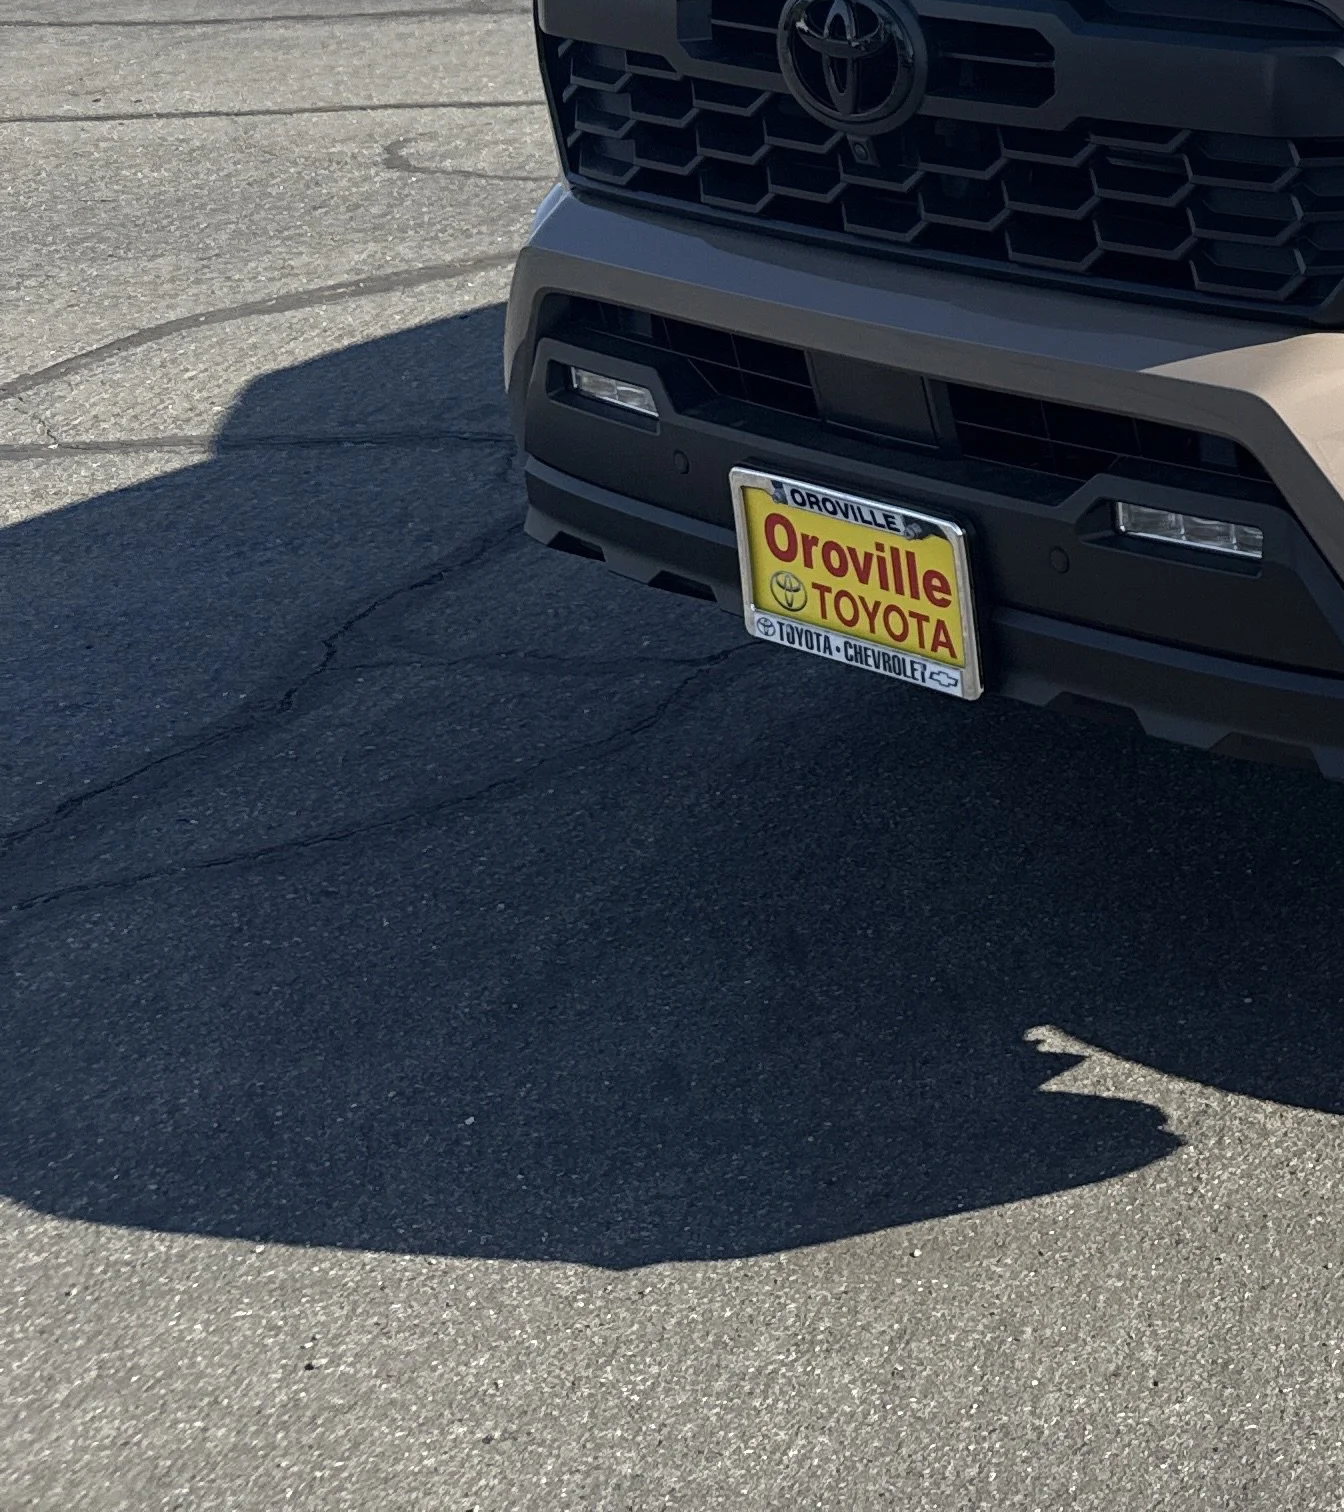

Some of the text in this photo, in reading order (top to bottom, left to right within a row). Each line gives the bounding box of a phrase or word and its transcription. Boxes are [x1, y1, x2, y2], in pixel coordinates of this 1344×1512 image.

[790, 488, 902, 533] OROVILLE
[764, 512, 952, 609] Oroville
[776, 620, 927, 684] TOYOTA CHEVROLET
[811, 582, 958, 659] TOYOTA
